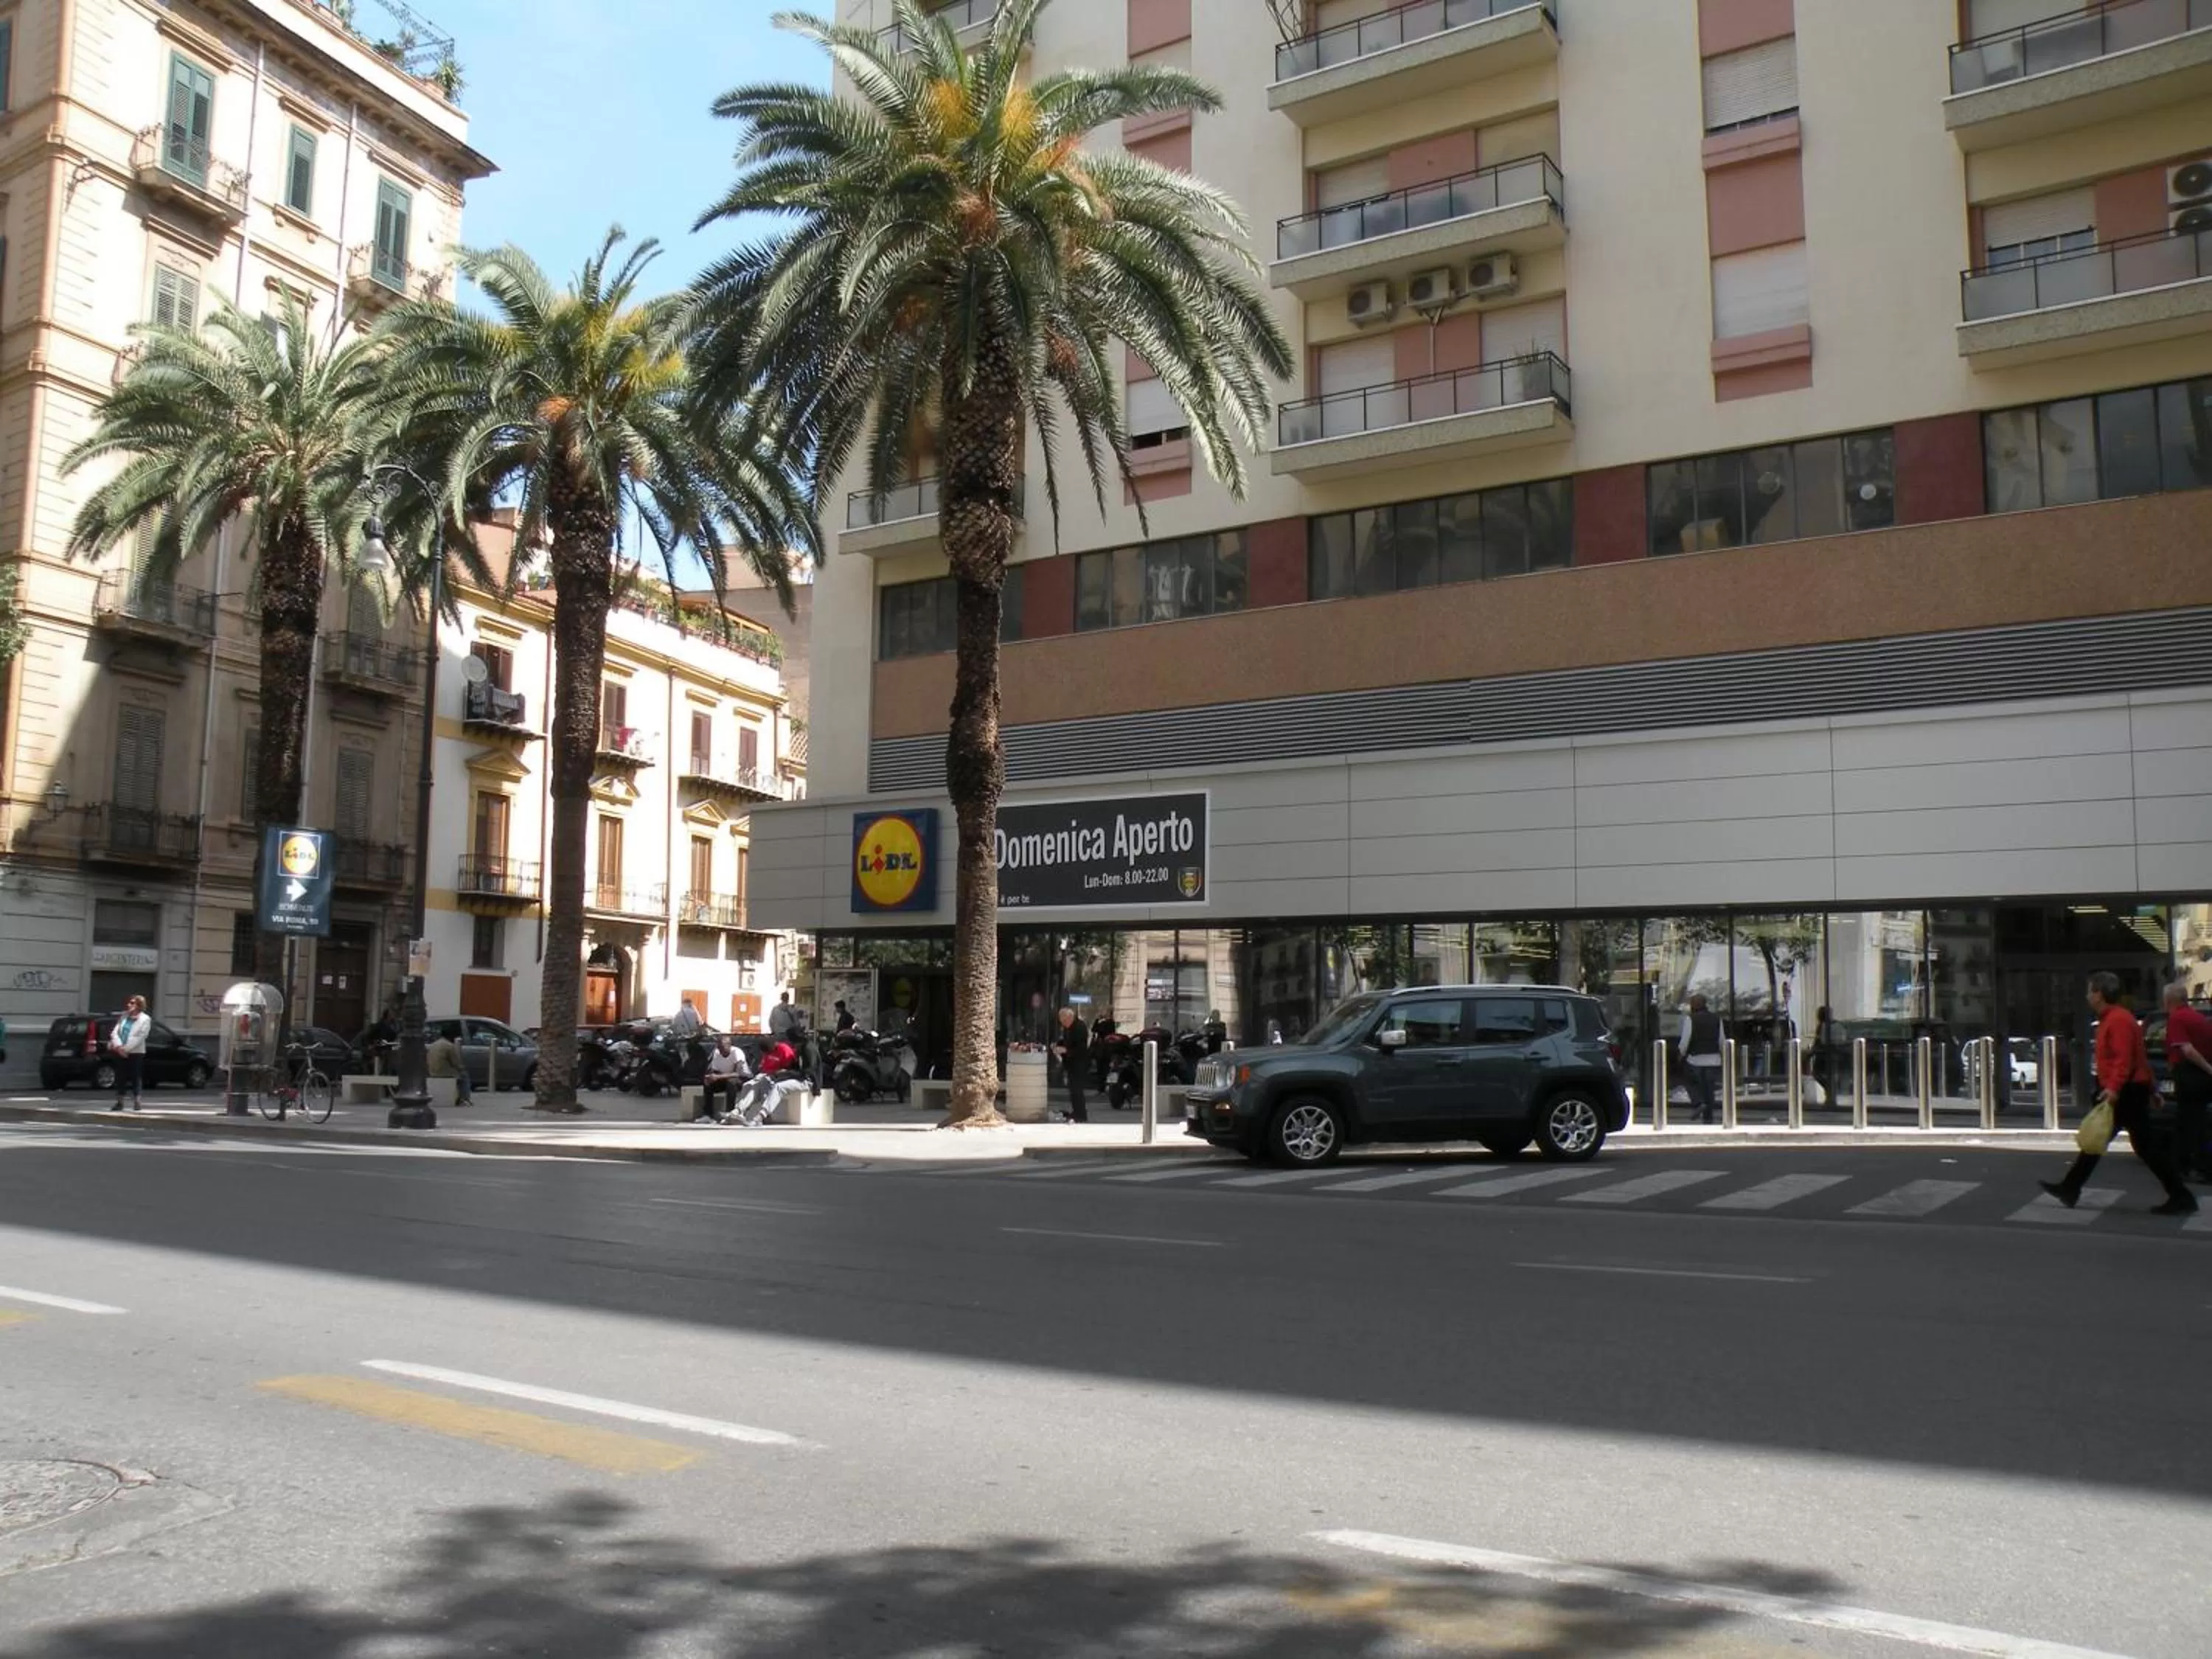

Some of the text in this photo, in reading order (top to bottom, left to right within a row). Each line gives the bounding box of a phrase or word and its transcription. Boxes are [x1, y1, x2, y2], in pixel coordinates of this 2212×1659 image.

[995, 810, 1194, 869] Domenica Aperto
[1124, 866, 1169, 885] 8.00-22.00
